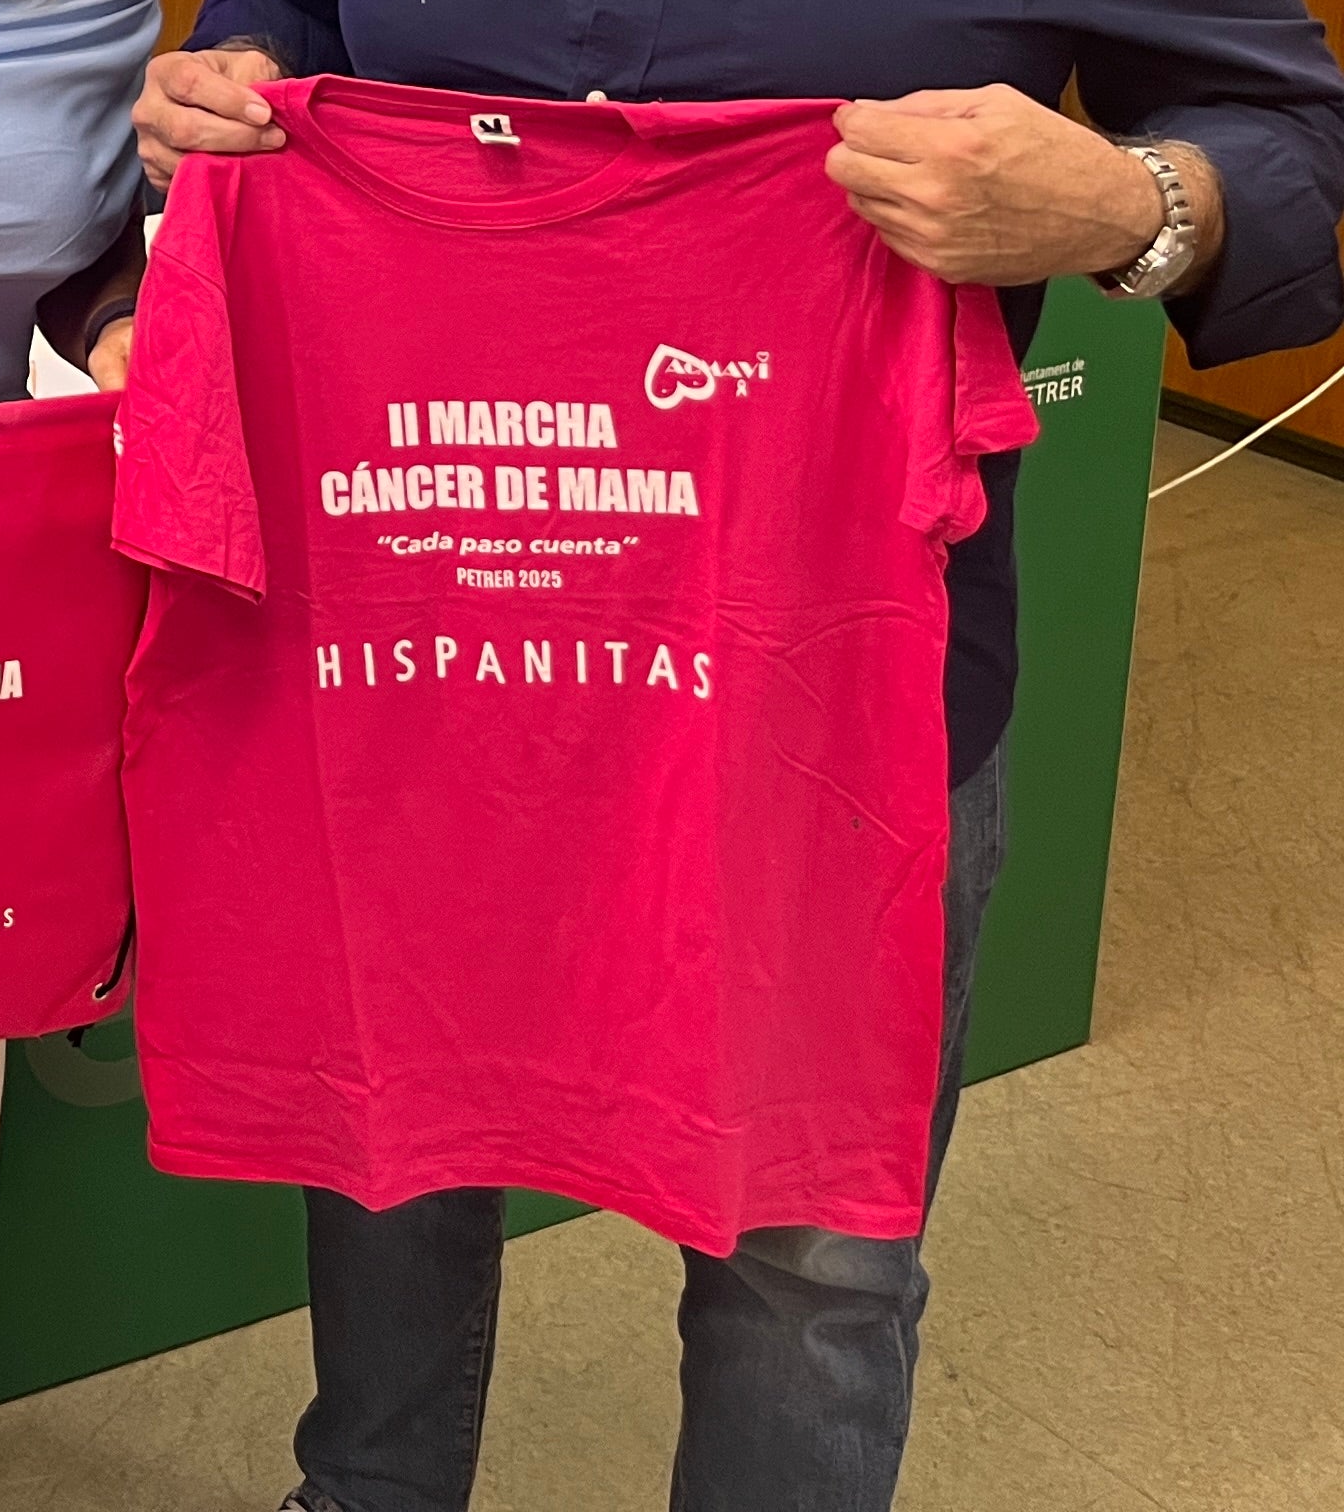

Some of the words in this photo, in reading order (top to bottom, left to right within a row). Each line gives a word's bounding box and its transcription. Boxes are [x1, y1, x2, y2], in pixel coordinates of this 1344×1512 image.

[387, 401, 419, 448] II
[428, 400, 618, 449] MARCHA
[320, 461, 486, 517] CÁNCER
[495, 465, 549, 511] DE
[557, 467, 700, 516] MAMA
[459, 536, 523, 557] paso
[456, 567, 514, 589] PETRER
[518, 568, 563, 589] 2025
[315, 635, 711, 700] HISPANITAS
